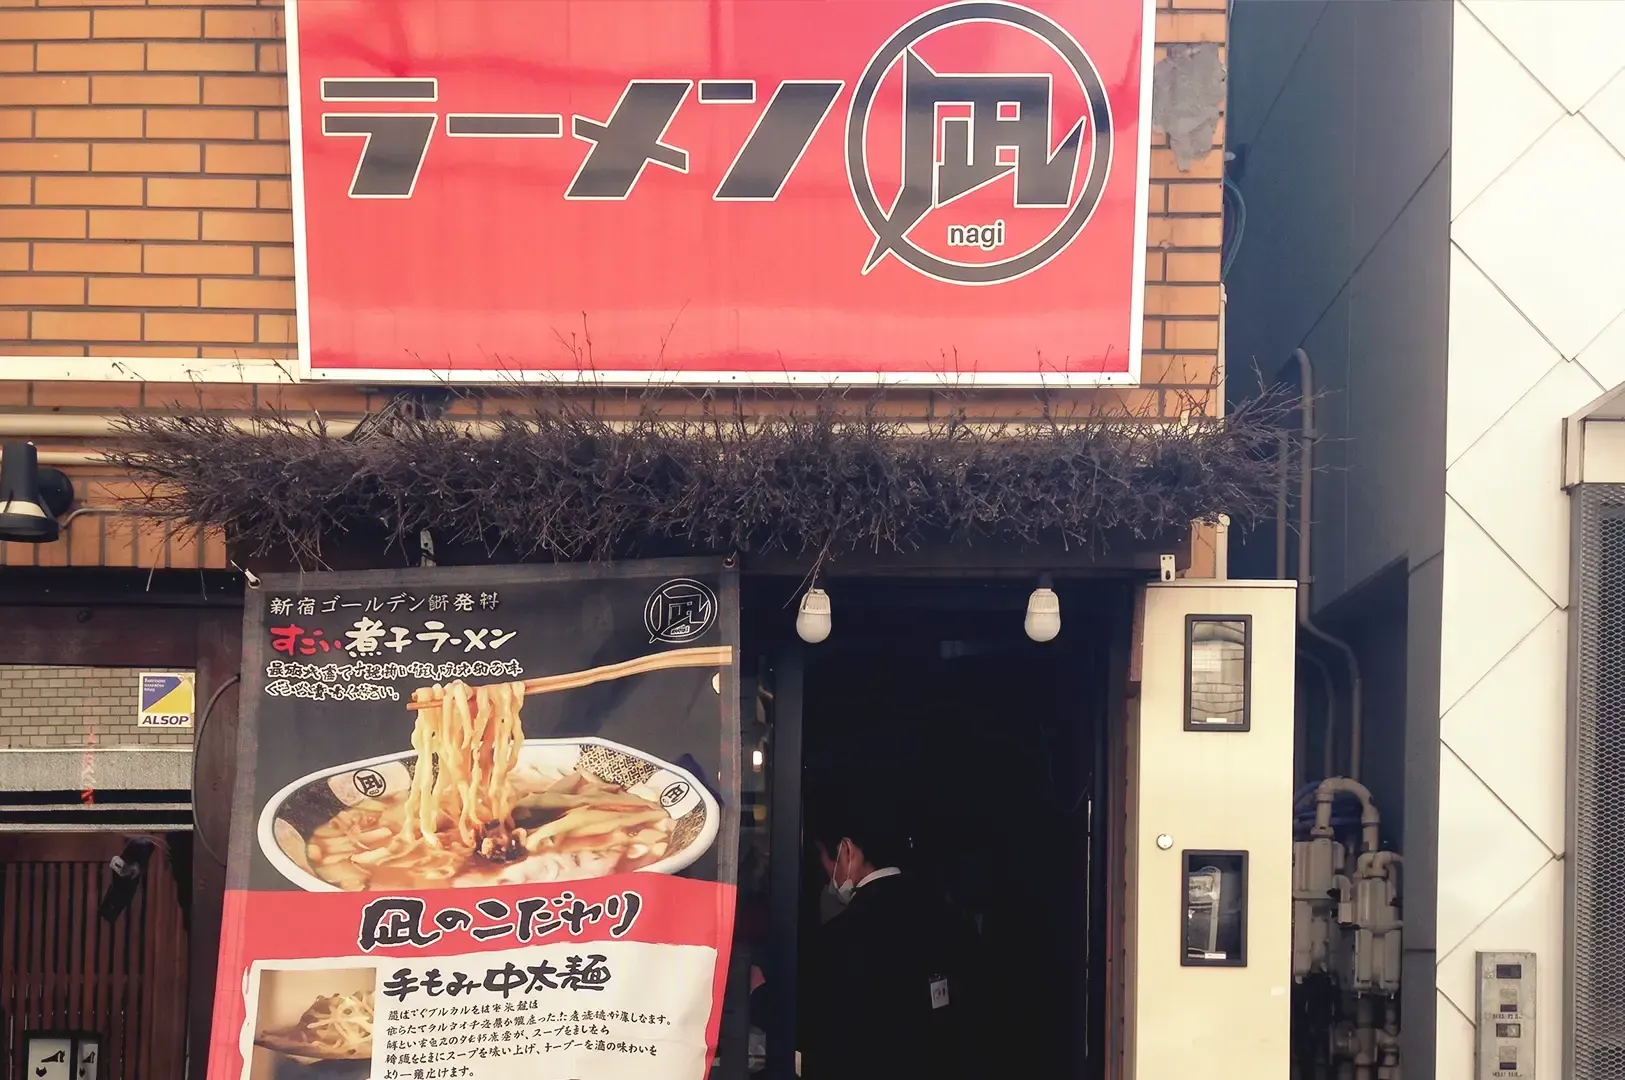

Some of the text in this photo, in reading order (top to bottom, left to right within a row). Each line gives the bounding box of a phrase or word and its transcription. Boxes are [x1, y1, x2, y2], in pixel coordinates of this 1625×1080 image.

[320, 77, 845, 202] ラーメン
[947, 219, 1005, 251] nagi
[142, 715, 190, 725] ALSOP
[358, 891, 641, 953] 凪のこだわり
[383, 954, 611, 1002] 手もみ中太麺
